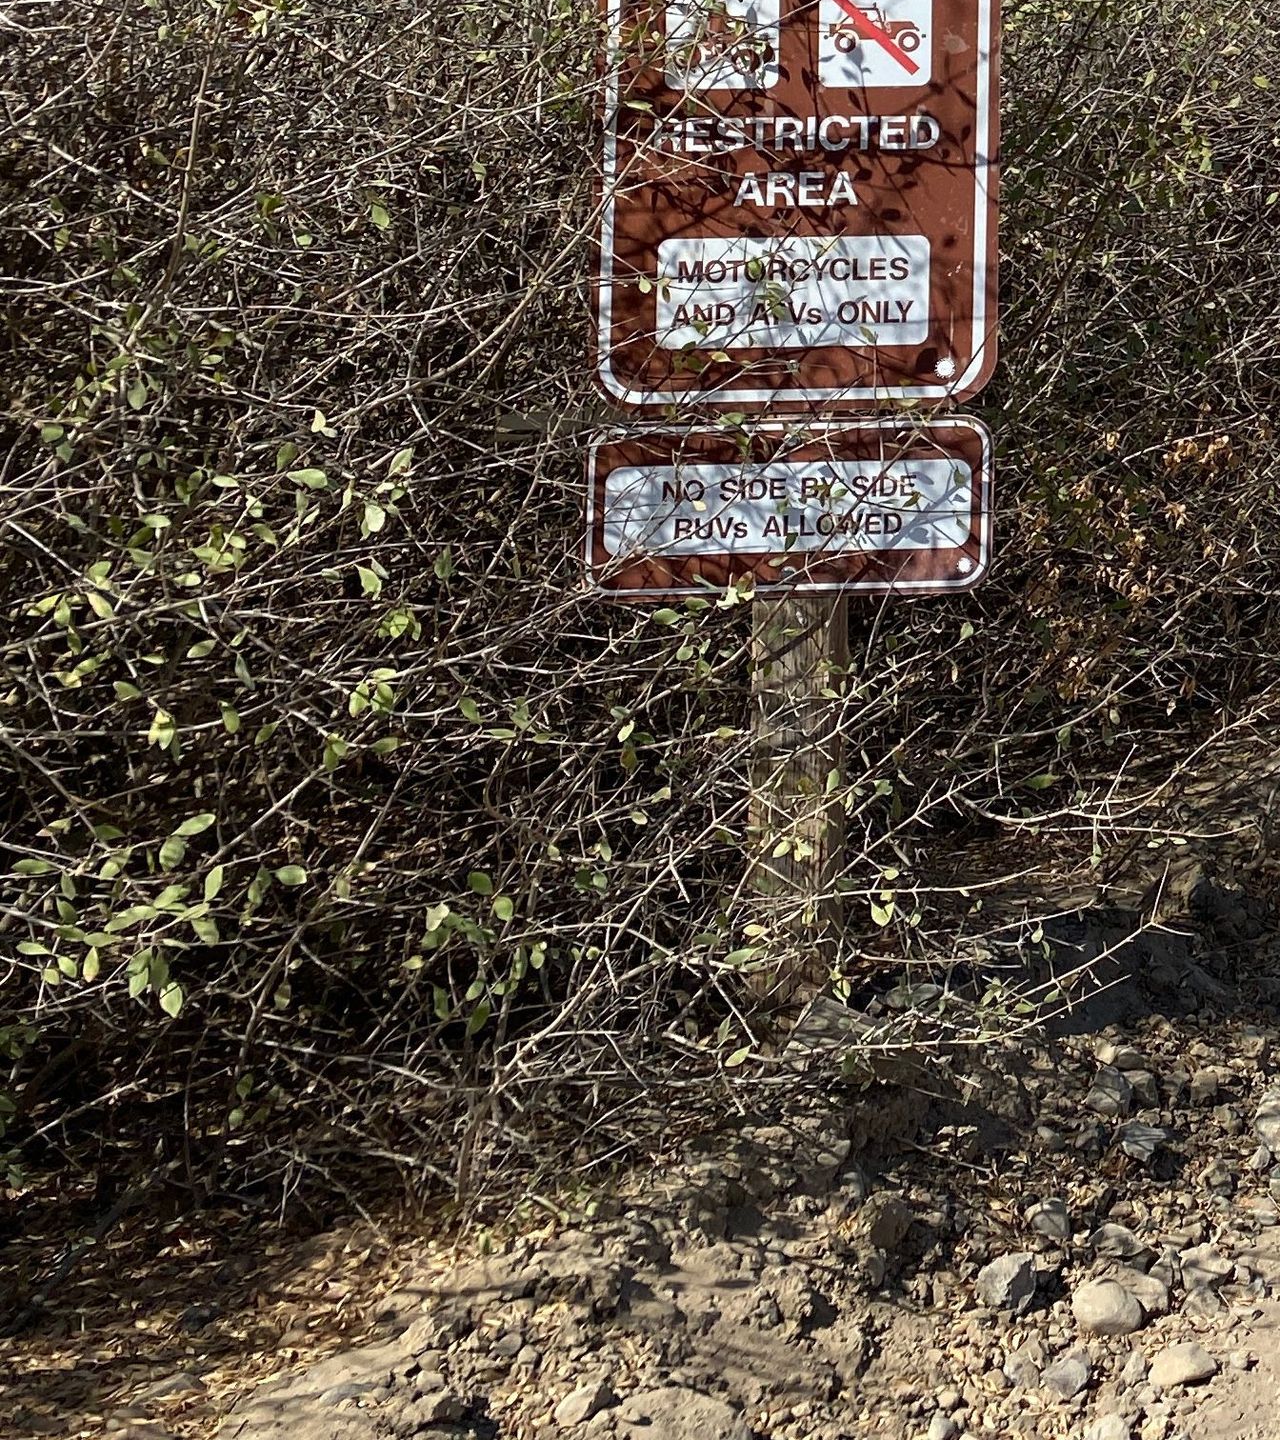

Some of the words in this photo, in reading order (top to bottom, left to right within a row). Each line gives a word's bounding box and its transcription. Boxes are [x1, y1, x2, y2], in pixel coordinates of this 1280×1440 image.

[653, 115, 940, 151] RESTRICTED
[733, 171, 858, 207] AREA
[677, 257, 909, 283] MOTORCYCLES
[670, 303, 735, 327] AND
[837, 300, 914, 324] ONLY
[661, 480, 705, 502] NO
[719, 478, 787, 501] SIDE
[852, 474, 917, 498] SIDE
[674, 516, 748, 540] RUVs
